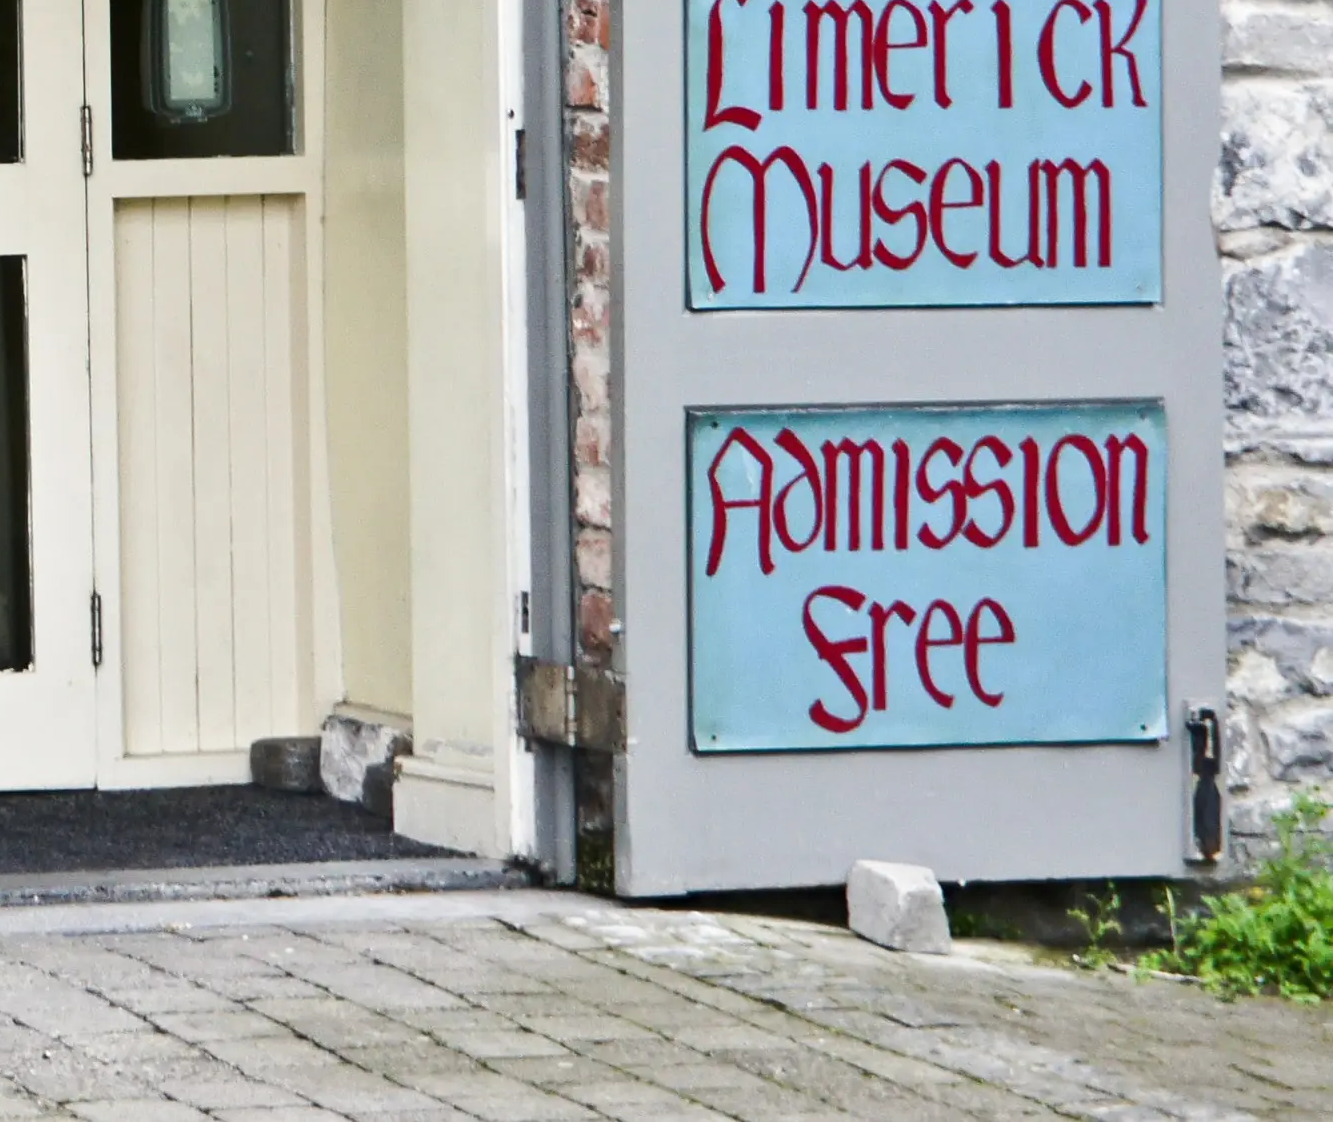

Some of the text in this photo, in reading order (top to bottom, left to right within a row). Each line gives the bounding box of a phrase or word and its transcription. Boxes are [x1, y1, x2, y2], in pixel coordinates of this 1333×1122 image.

[700, 145, 1113, 294] Museum
[705, 426, 1151, 577] Admission
[802, 585, 1016, 734] Free
